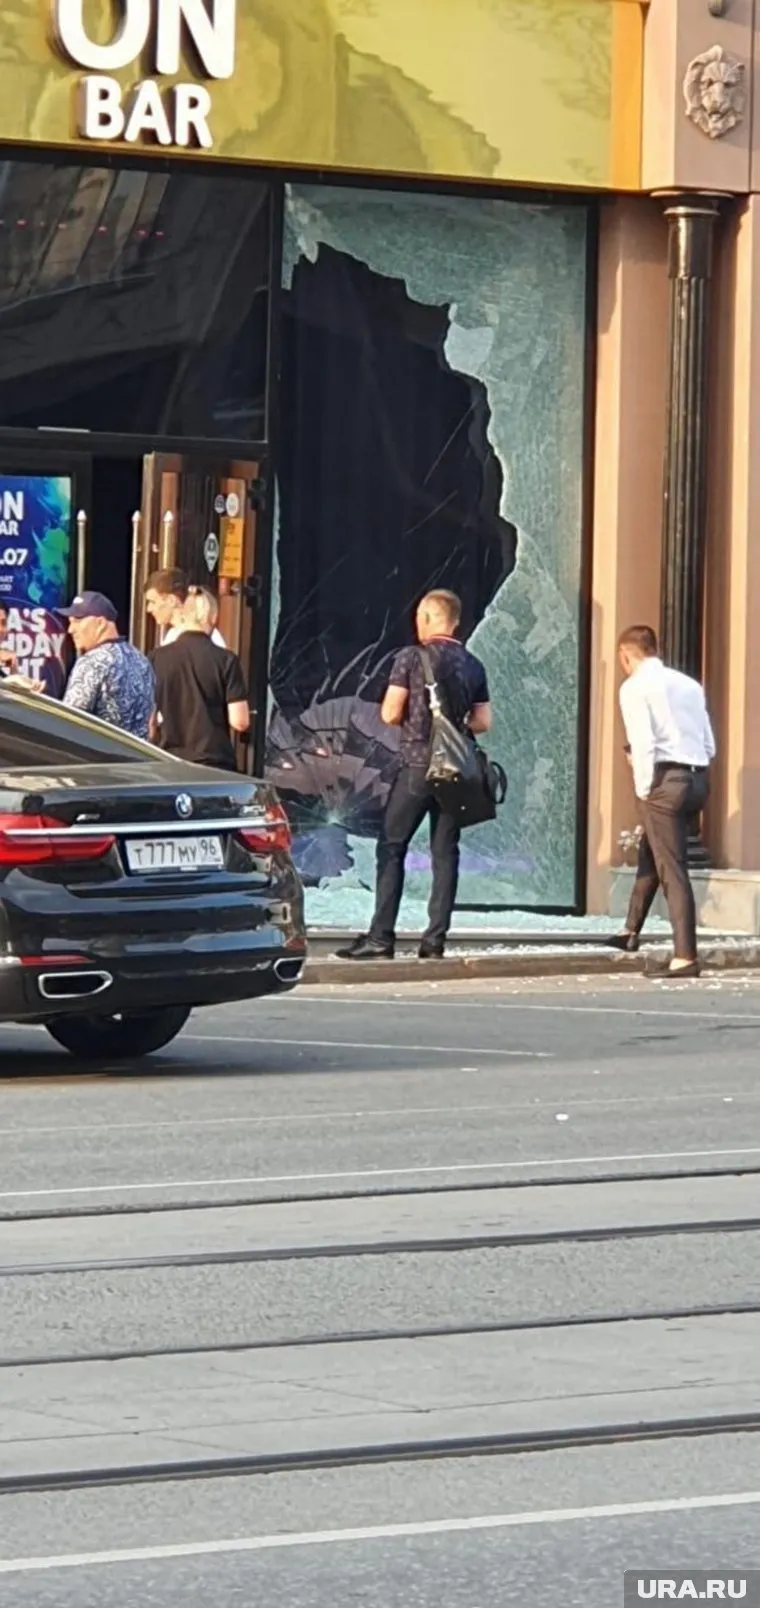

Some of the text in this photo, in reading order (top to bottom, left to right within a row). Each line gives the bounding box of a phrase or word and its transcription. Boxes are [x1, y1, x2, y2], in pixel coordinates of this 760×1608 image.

[54, 0, 236, 79] ON
[80, 75, 213, 149] BAR
[0, 490, 24, 521] N
[134, 838, 216, 865] Т777МУ 96
